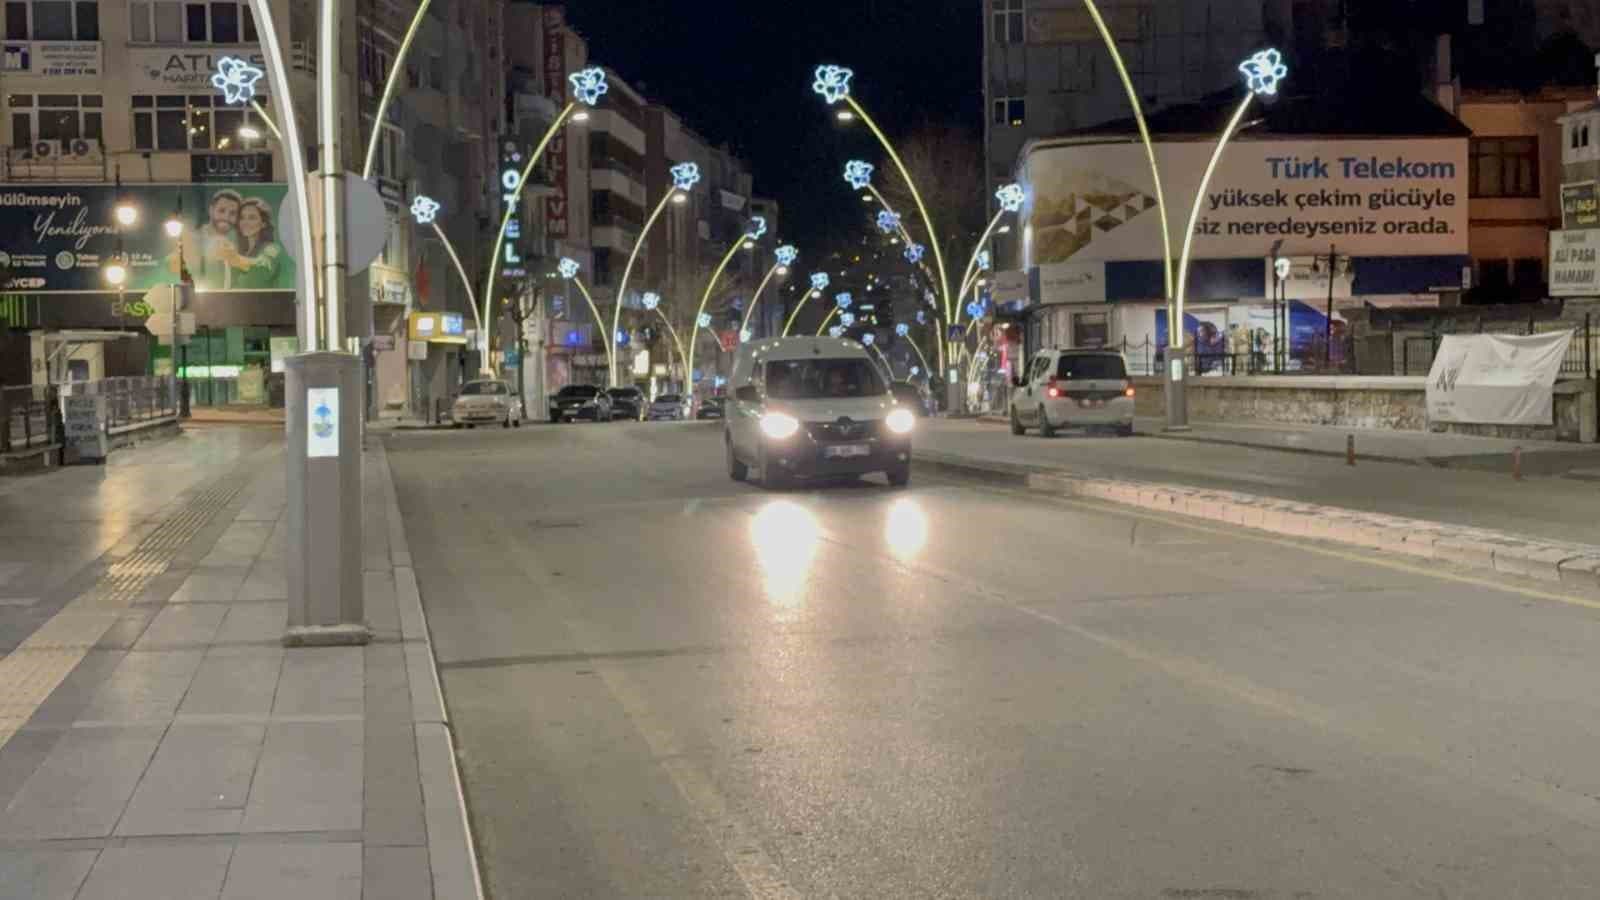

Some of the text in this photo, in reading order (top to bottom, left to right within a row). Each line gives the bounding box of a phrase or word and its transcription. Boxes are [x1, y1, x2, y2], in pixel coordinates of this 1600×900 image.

[1266, 156, 1455, 179] Türk Telekom
[1209, 188, 1455, 211] yüksek çekim gücüyle
[502, 169, 521, 263] OTEL
[1228, 216, 1376, 238] neredeyseniz
[1383, 216, 1455, 234] orada.
